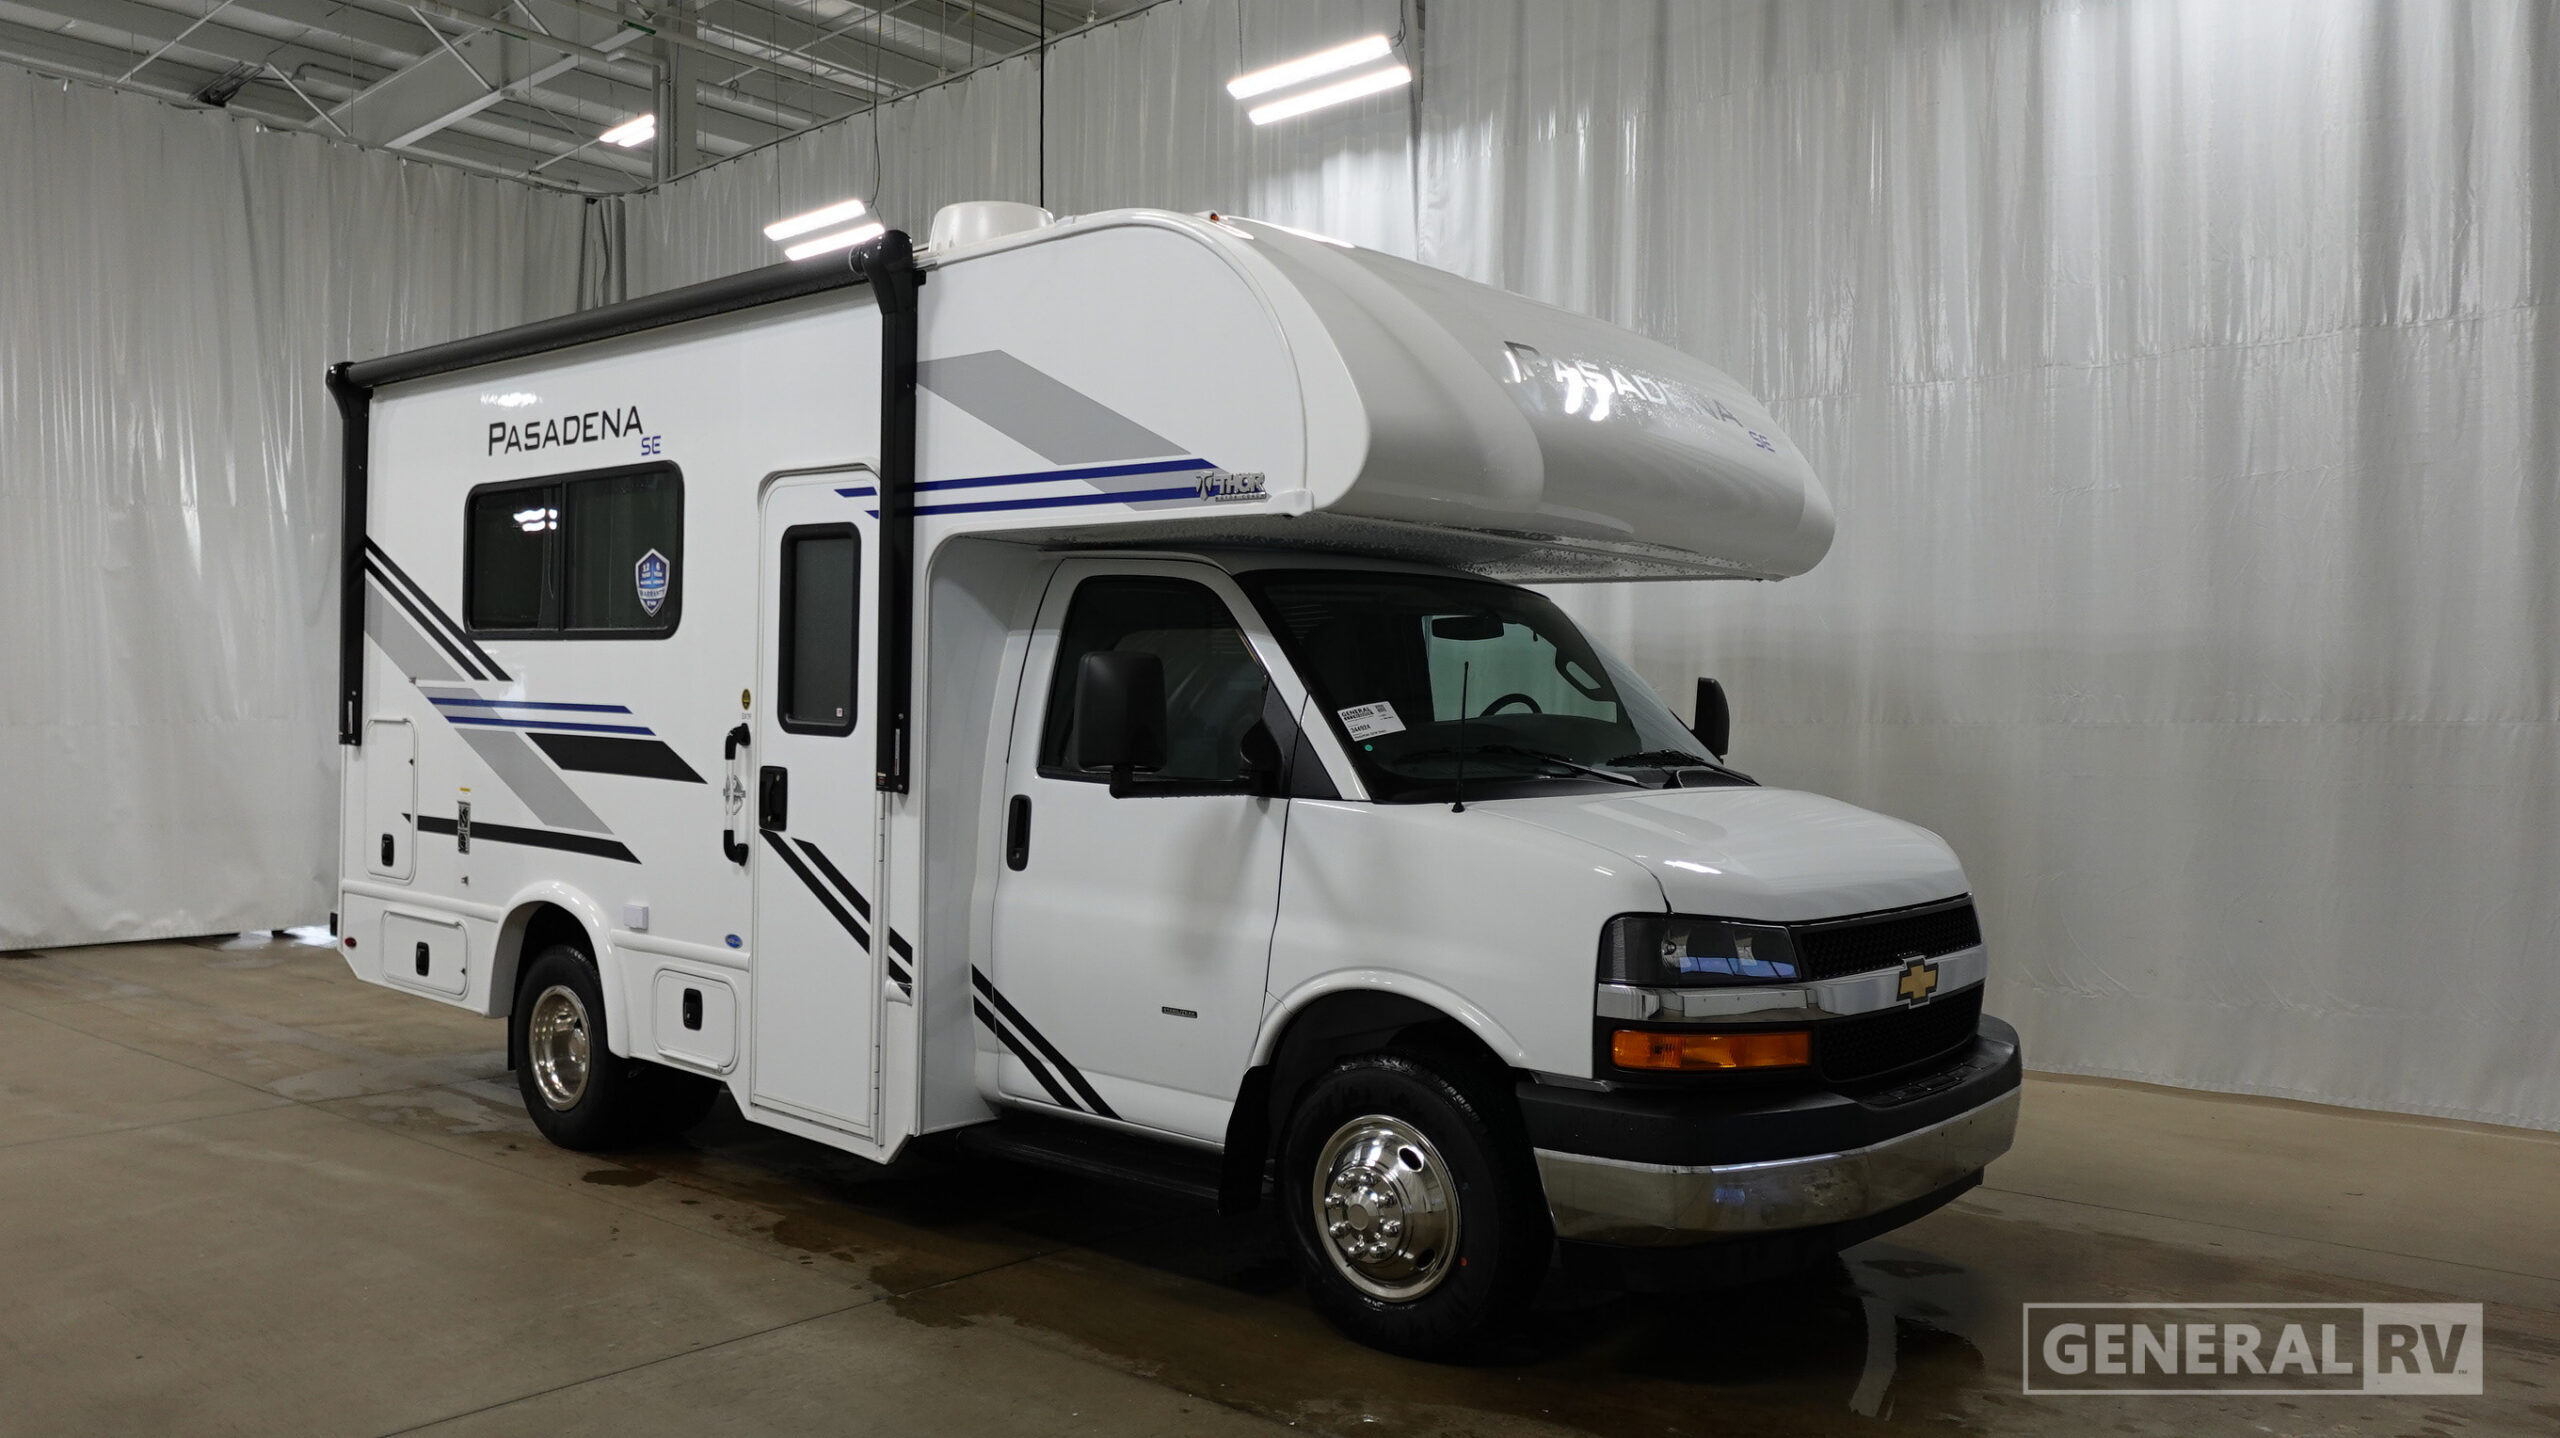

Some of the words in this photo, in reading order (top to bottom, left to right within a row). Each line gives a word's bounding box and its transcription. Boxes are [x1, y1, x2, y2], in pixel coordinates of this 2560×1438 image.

[488, 405, 644, 456] PASADENA
[1749, 430, 1775, 452] SE
[641, 435, 661, 456] SE
[1216, 472, 1266, 495] THOR
[1341, 707, 1371, 717] GENERAL
